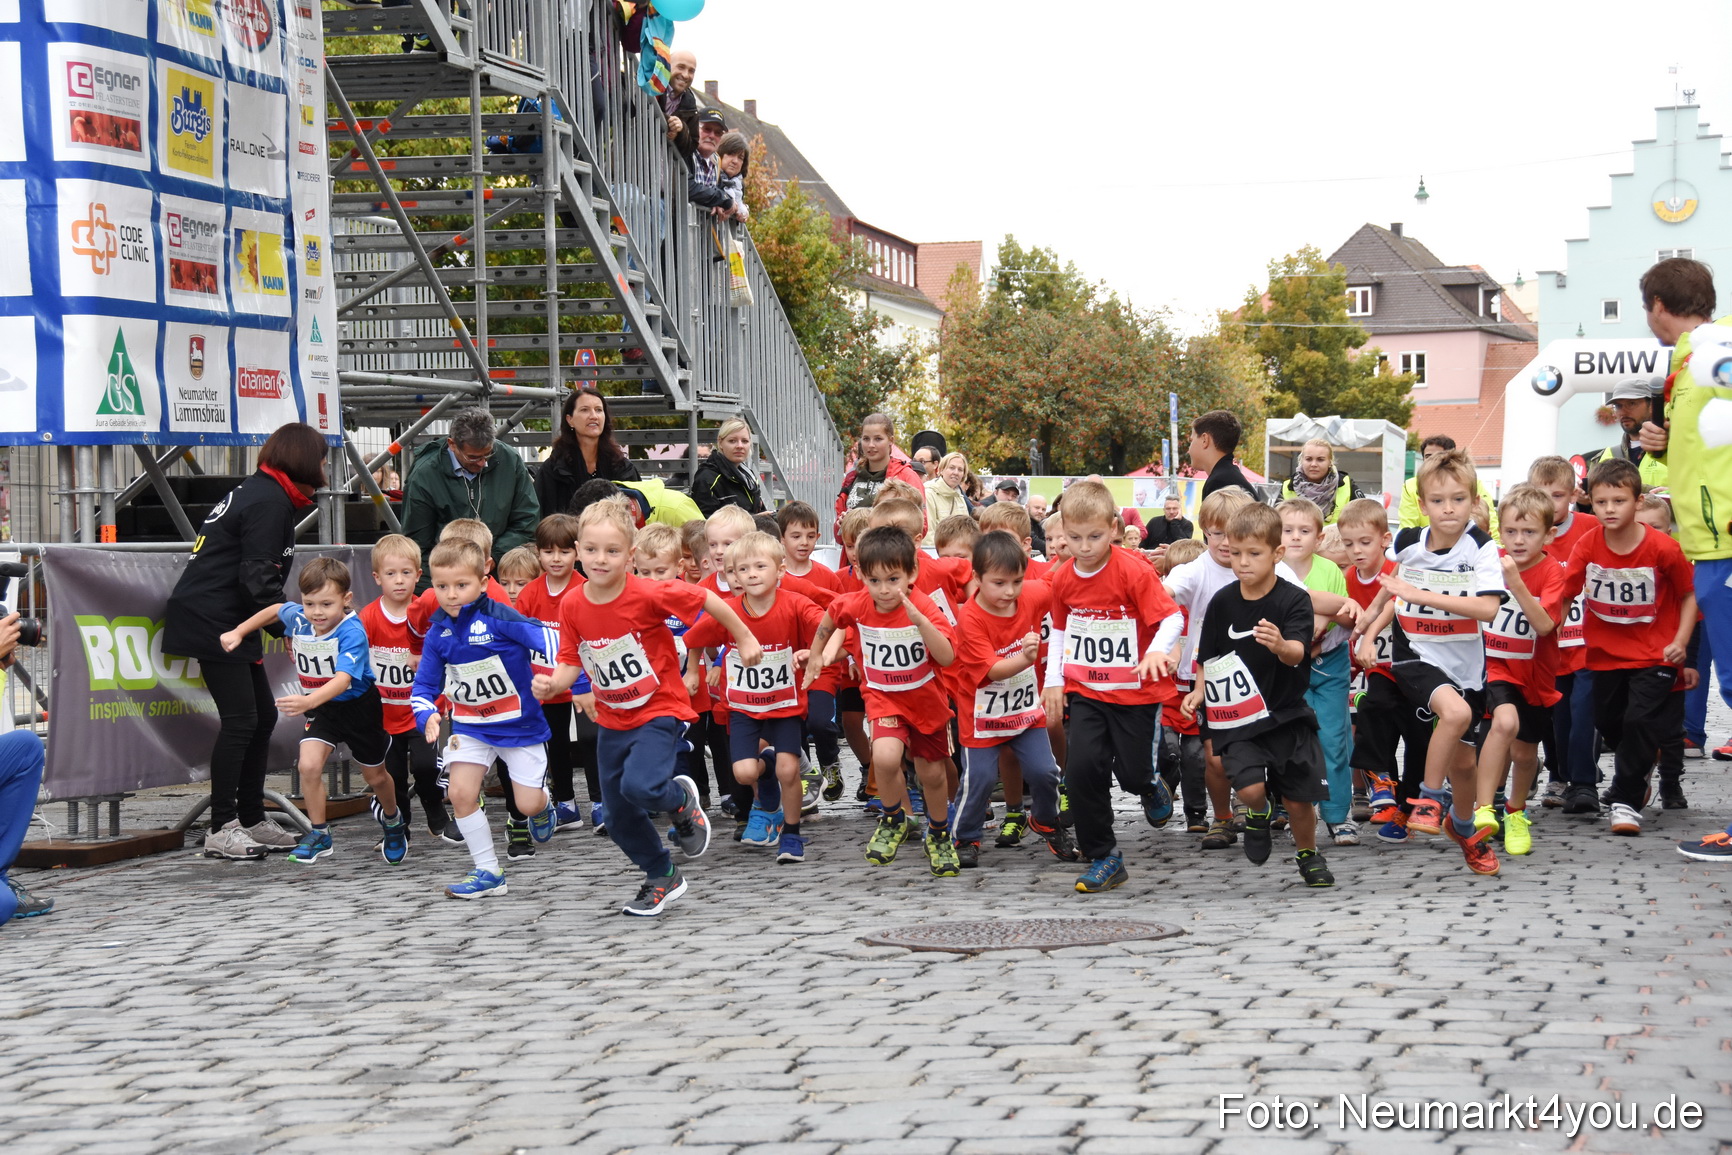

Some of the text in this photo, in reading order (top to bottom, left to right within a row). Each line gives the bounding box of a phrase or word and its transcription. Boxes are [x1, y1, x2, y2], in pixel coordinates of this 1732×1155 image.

[189, 11, 213, 31] KANN
[95, 91, 140, 109] PFLASTERSTEINE
[171, 95, 211, 142] Burgis
[120, 225, 143, 244] CODE
[121, 245, 150, 263] CLINIC
[262, 275, 284, 291] KANN
[1573, 350, 1659, 375] BMW
[178, 386, 218, 402] Neumarkter
[173, 402, 226, 424] Lammsbräu
[96, 418, 108, 428] Jura
[1428, 572, 1470, 583] BOCK
[1591, 578, 1647, 603] 7181
[1610, 607, 1629, 617] Erik
[1415, 620, 1455, 634] Patrick
[865, 641, 925, 668] 7206
[1070, 634, 1132, 664] 7094
[733, 663, 790, 690] 7034
[883, 672, 914, 684] Timur
[1088, 670, 1110, 681] Max
[450, 673, 508, 703] 240
[601, 686, 641, 703] Leopold
[746, 694, 777, 705] Lionez
[984, 683, 1035, 715] 7125
[985, 714, 1037, 730] Maximilian
[1212, 709, 1240, 720] Vitus
